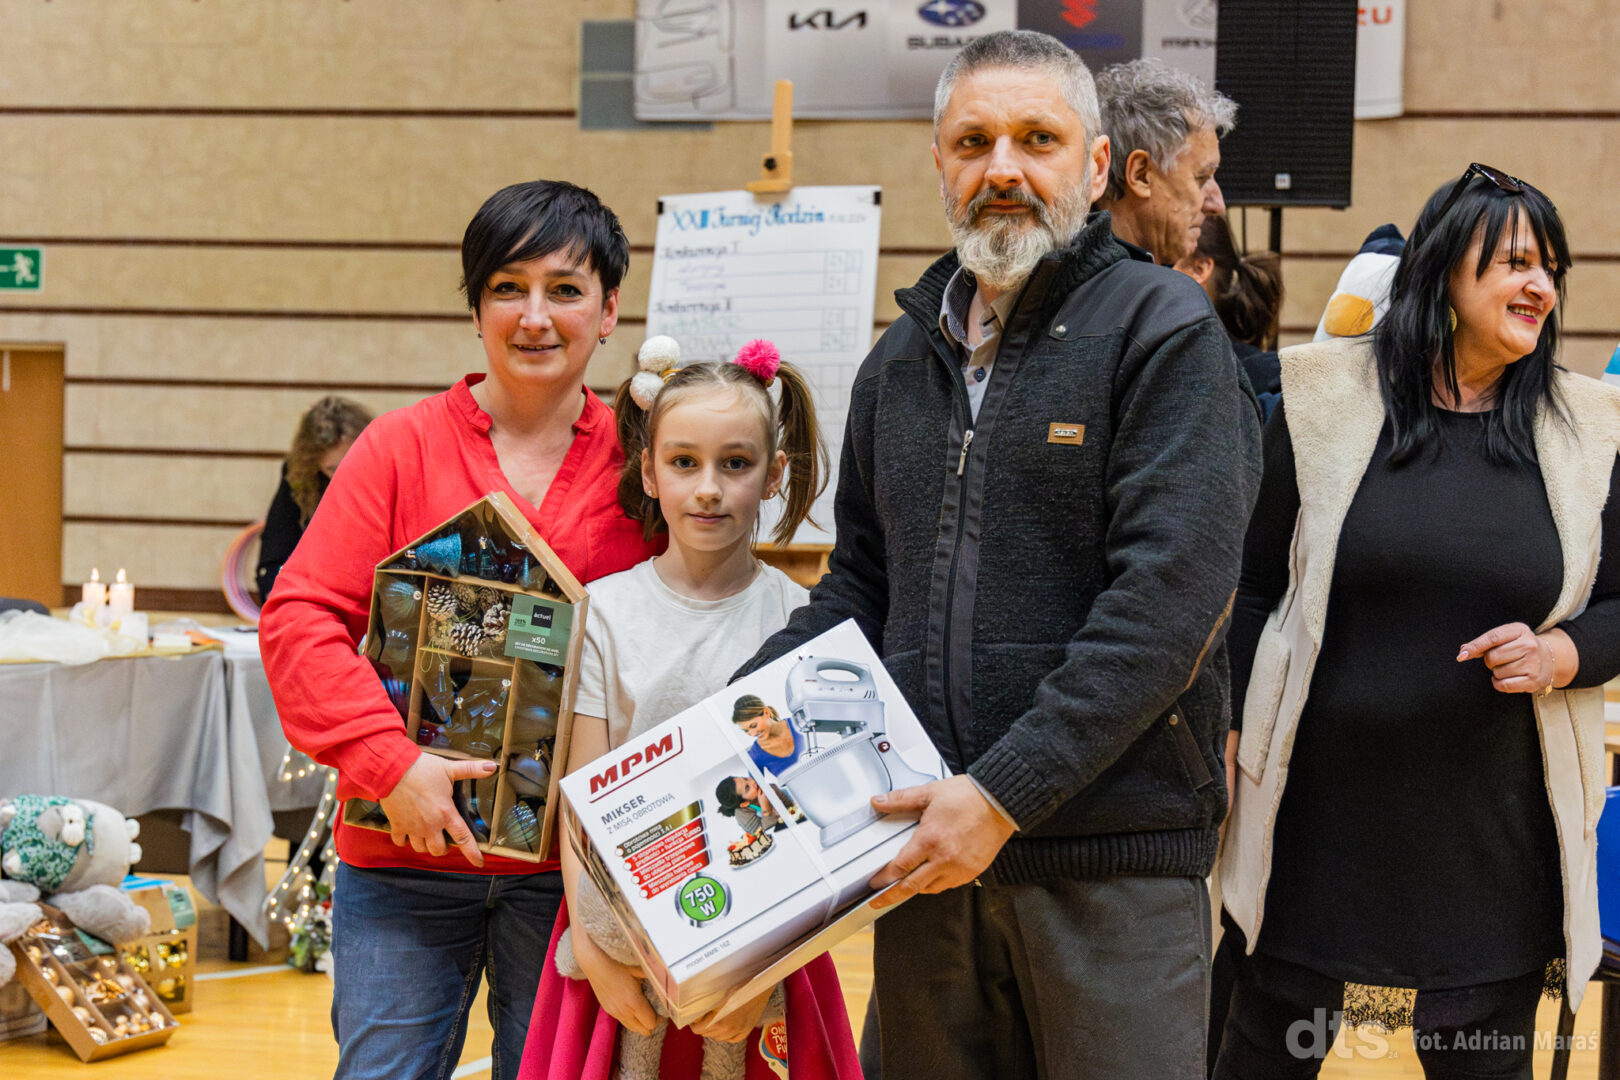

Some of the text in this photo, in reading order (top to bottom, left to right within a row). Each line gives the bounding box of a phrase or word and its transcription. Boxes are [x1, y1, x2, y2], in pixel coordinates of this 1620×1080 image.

[589, 733, 674, 795] MPM
[600, 794, 646, 824] MIKSER
[606, 792, 675, 834] Z MISĄ OBROTOWĄ
[685, 884, 716, 908] 750
[700, 903, 717, 918] W
